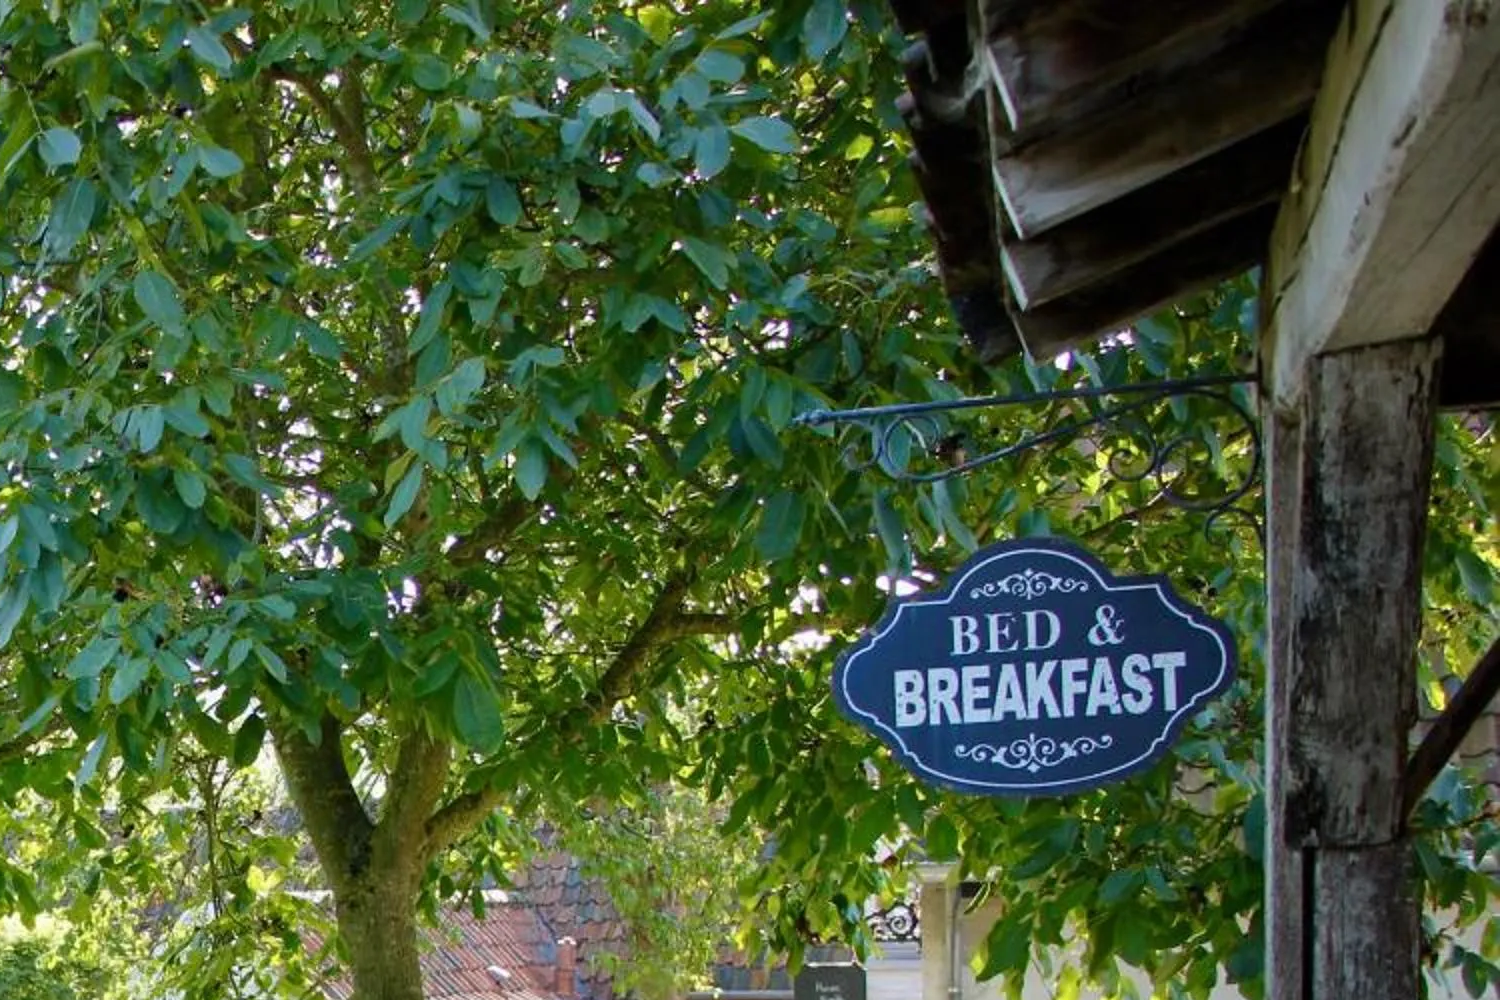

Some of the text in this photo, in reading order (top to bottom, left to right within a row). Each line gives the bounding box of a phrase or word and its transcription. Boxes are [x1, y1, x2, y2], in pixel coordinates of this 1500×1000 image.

[949, 604, 1126, 656] BED &
[893, 651, 1187, 729] BREAKFAST
